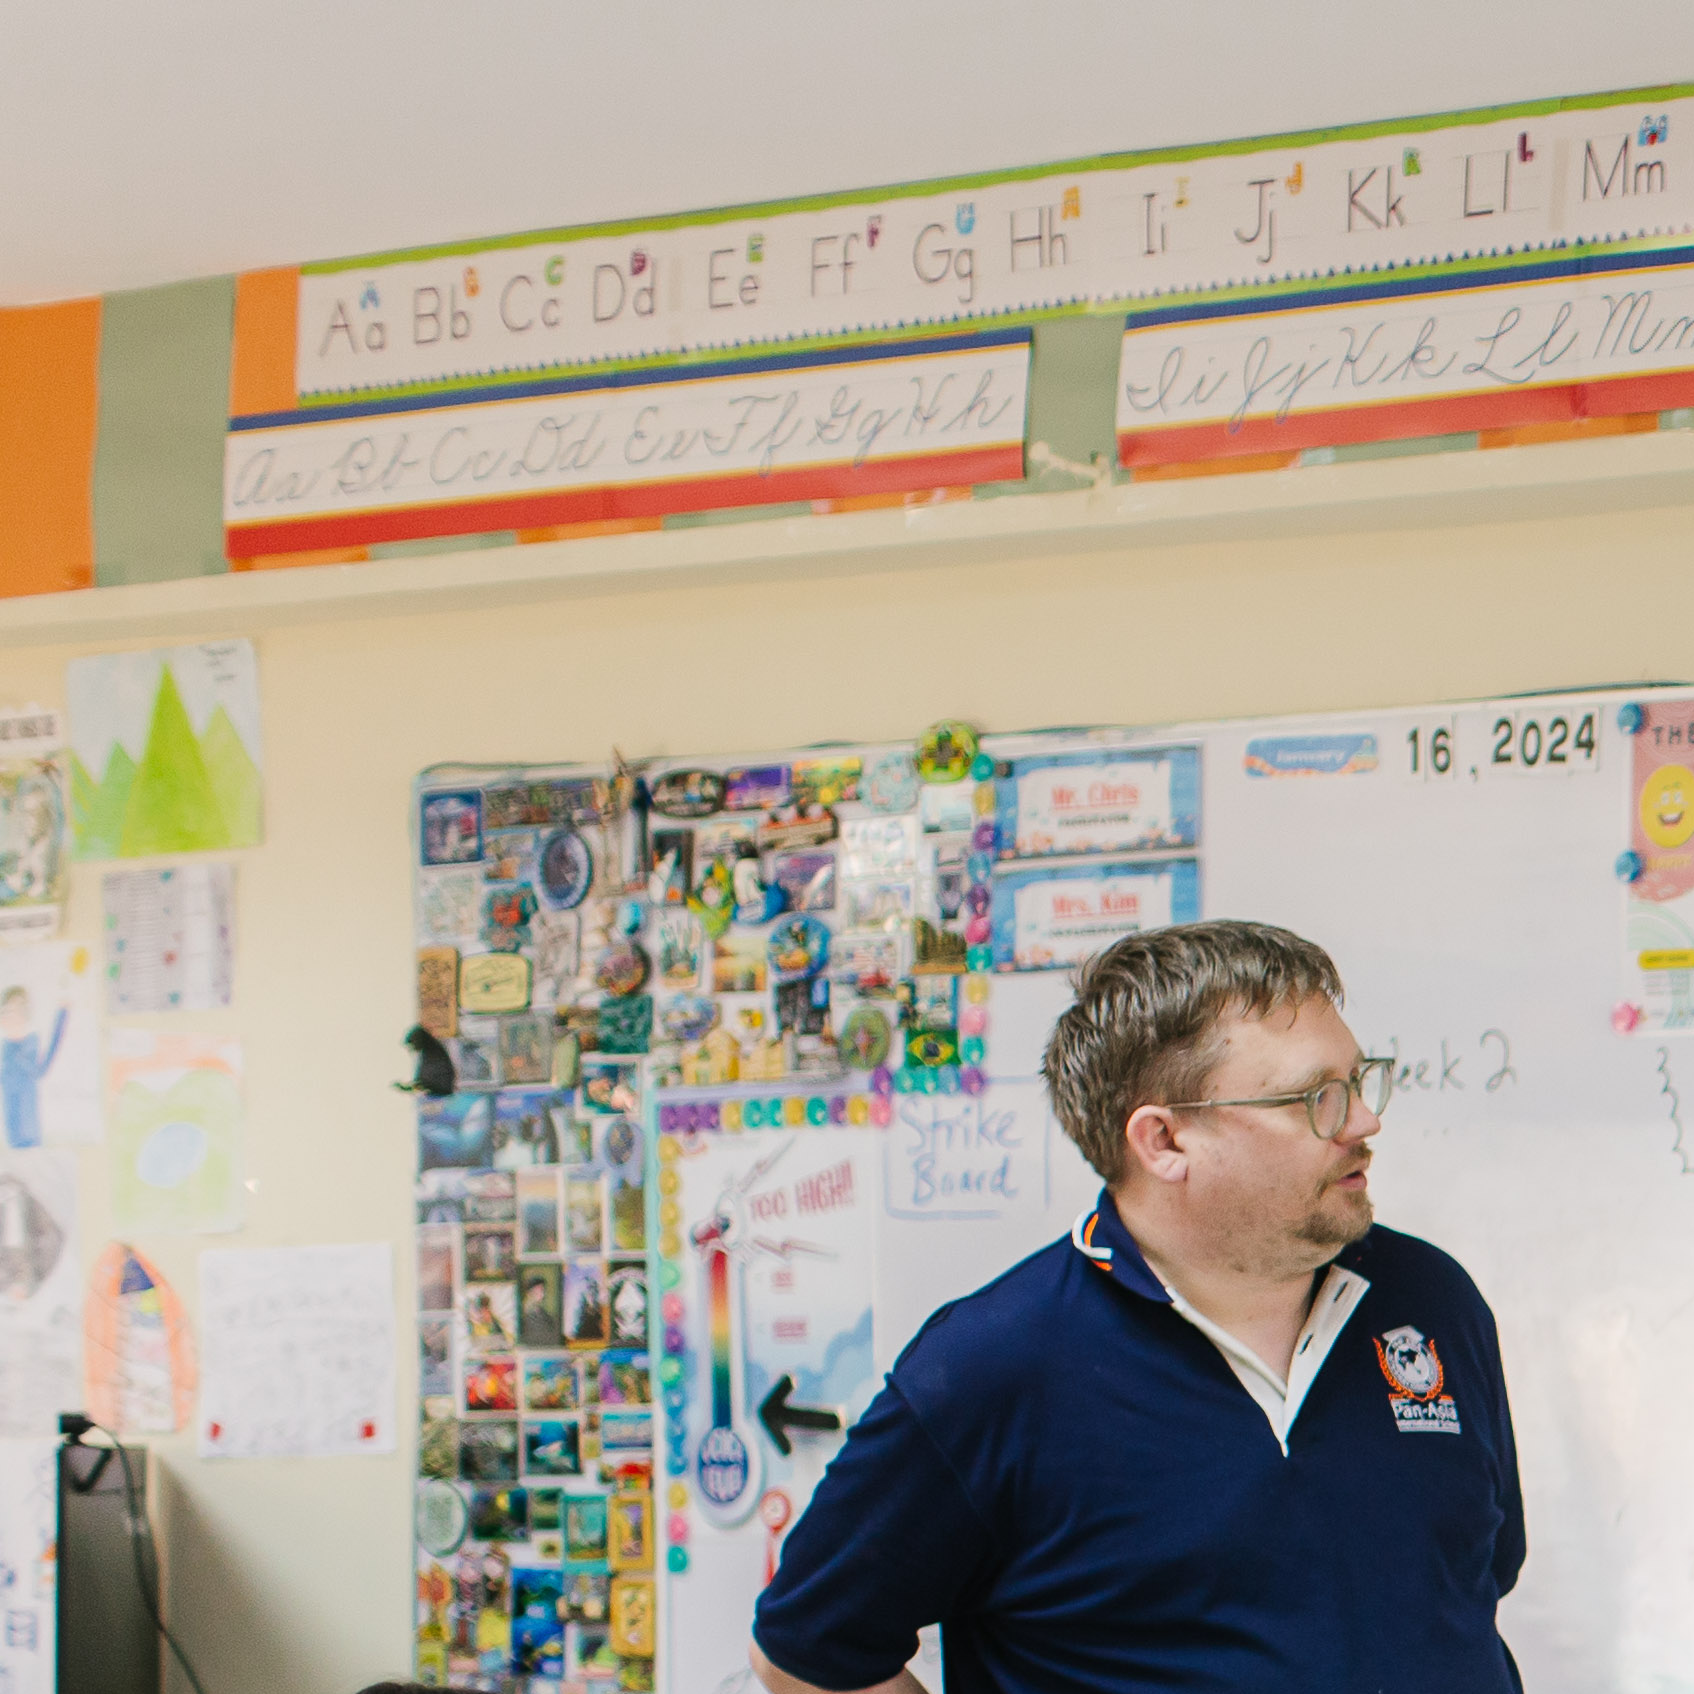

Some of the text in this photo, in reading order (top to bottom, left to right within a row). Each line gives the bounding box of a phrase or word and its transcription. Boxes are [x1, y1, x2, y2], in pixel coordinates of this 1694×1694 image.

[708, 248, 760, 310] Ee
[809, 232, 858, 298] Ff
[913, 221, 975, 304] Gg
[1347, 165, 1406, 234] Kk
[1583, 139, 1665, 202] Mm
[1492, 714, 1595, 766] 2024
[1480, 1028, 1517, 1092] 2
[901, 1100, 1023, 1154] Strike
[914, 1154, 1018, 1206] Board
